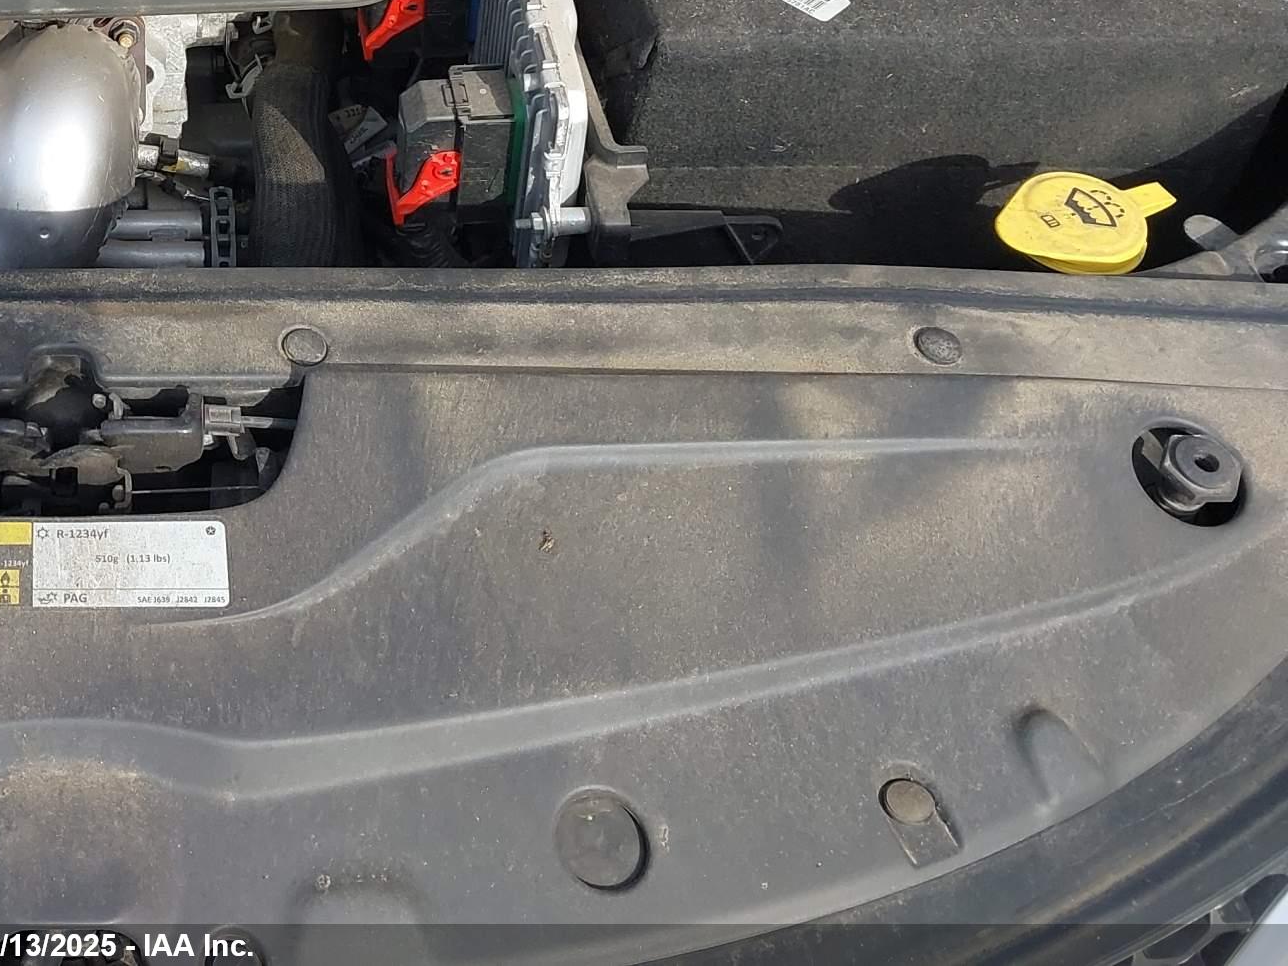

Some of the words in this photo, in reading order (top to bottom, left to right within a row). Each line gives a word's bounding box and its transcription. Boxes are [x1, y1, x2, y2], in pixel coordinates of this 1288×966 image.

[56, 528, 110, 541] R-1234yf
[126, 554, 150, 565] (1.13
[152, 553, 171, 565] lbs)
[63, 593, 88, 604] PAG
